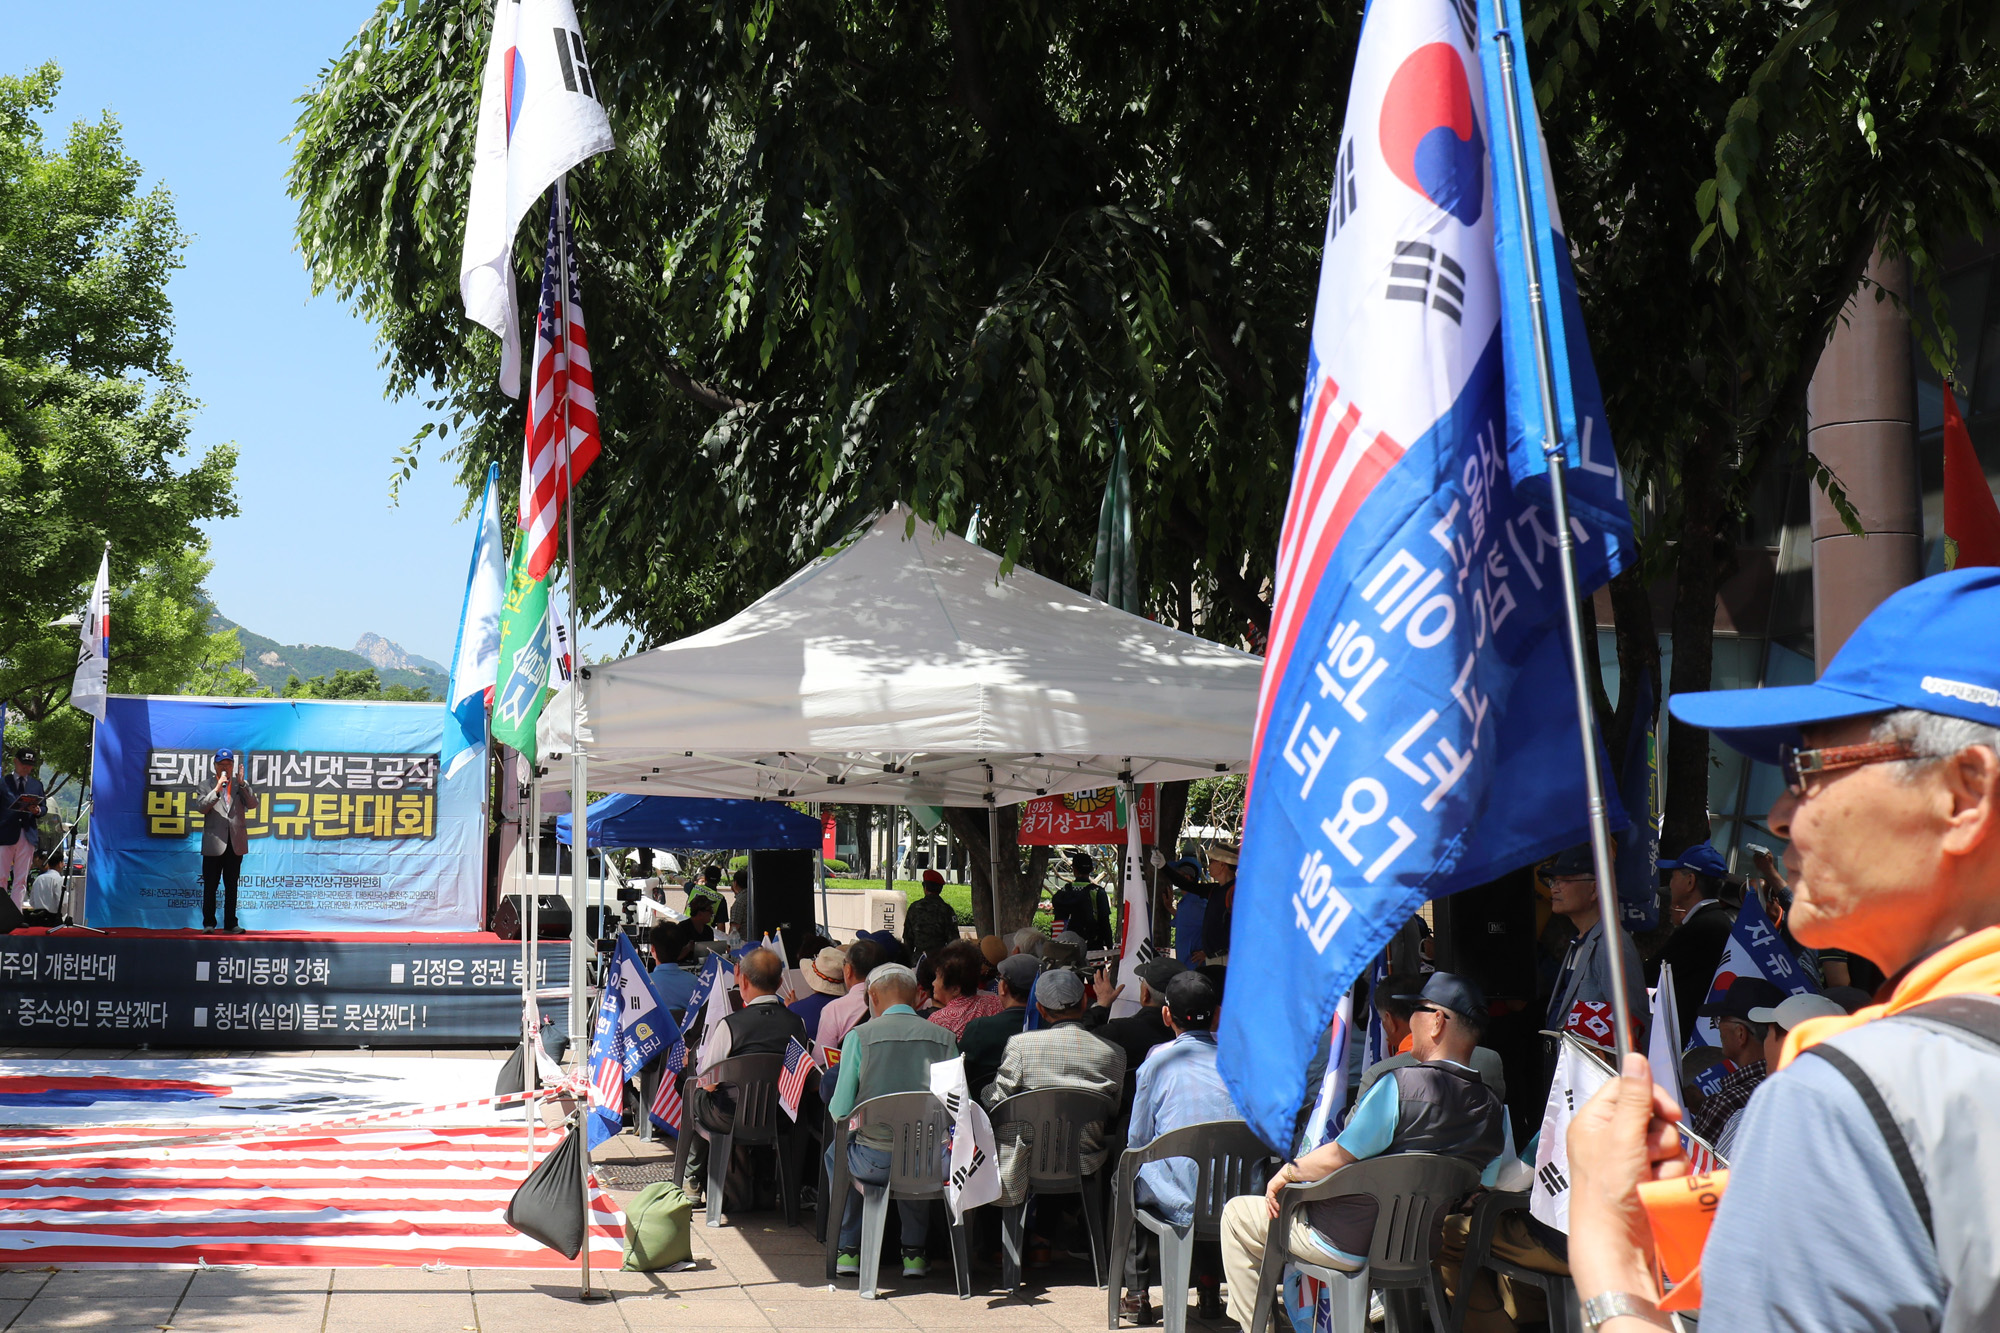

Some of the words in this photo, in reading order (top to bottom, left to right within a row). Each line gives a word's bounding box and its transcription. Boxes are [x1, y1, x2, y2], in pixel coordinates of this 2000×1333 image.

[252, 754, 438, 789] 대선댓글공작
[1027, 801, 1053, 814] 1923
[0, 952, 38, 981] 주의
[45, 953, 117, 982] 개헌반대
[217, 957, 289, 986] 한미동맹
[294, 958, 330, 986] 강화
[411, 958, 465, 986] 김정은
[470, 958, 506, 986] 정권
[18, 998, 90, 1028] 중소상인
[95, 1000, 168, 1030] 못살겠다
[214, 1001, 339, 1031] 청년(실업)들도
[344, 1001, 417, 1031] 못살겠다
